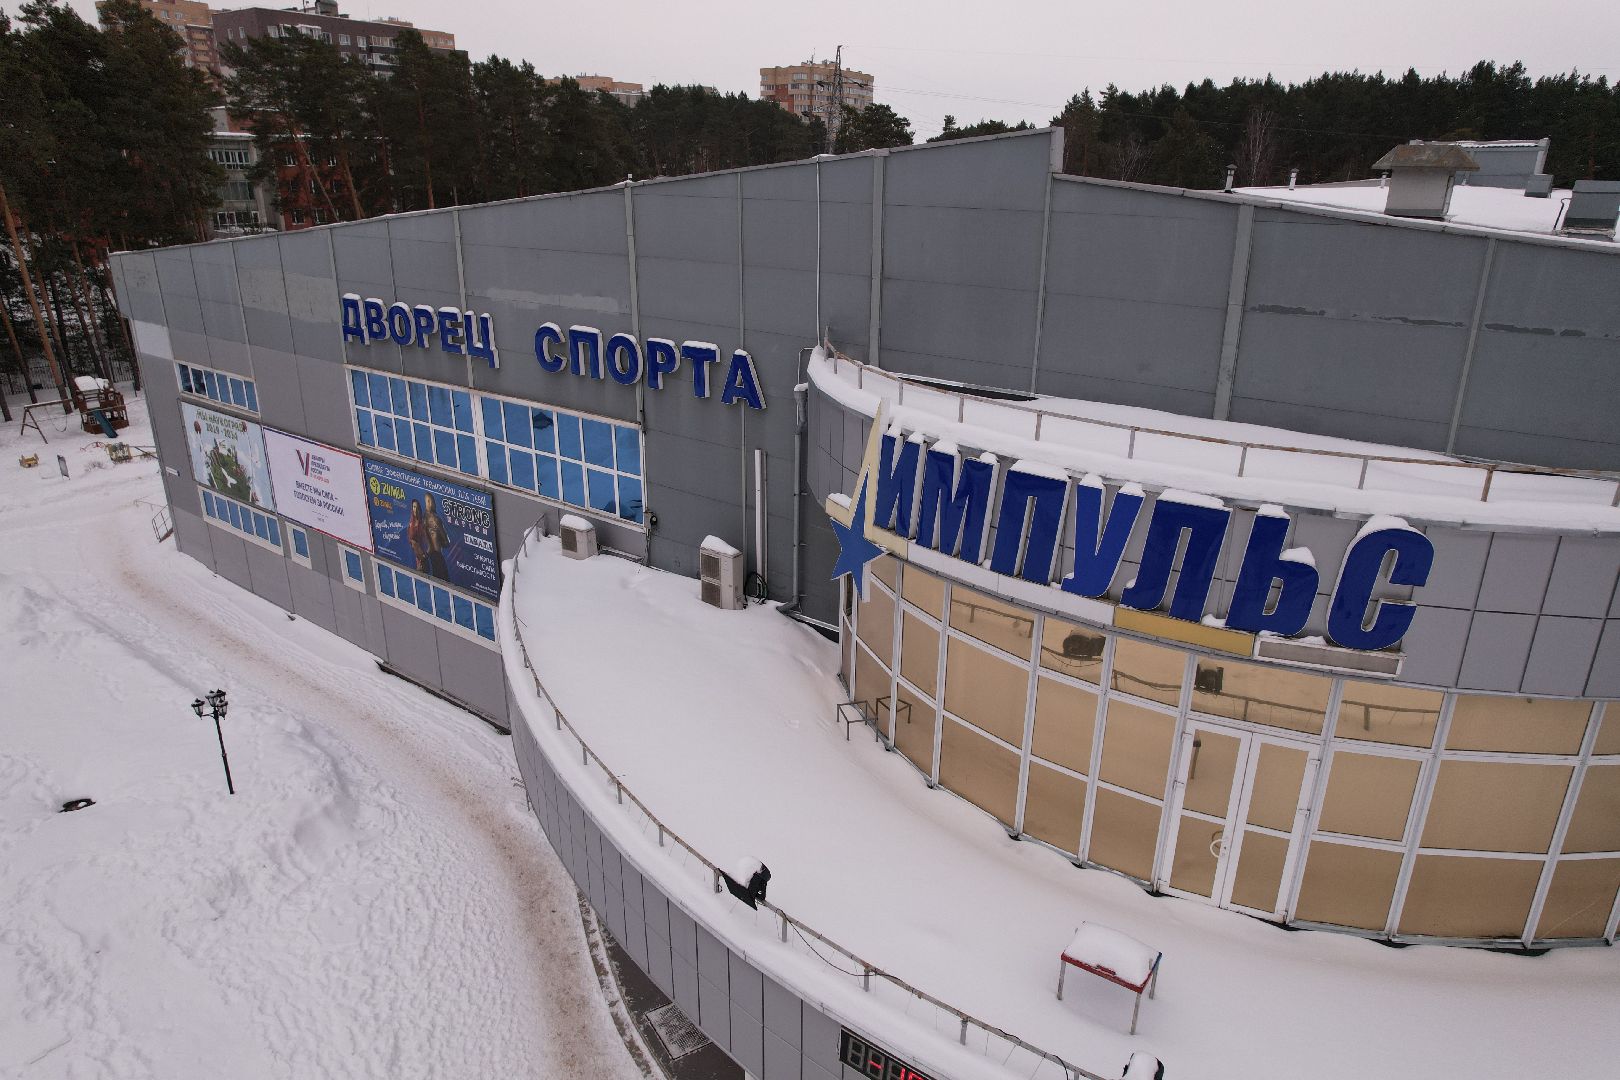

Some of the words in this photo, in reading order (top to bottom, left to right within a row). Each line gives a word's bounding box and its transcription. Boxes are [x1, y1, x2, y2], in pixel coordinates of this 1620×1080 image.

[342, 293, 499, 369] ДВОРЕЦ
[535, 322, 767, 410] СПОРТА
[381, 482, 406, 501] ZUMBA
[442, 498, 491, 529] STRONG
[872, 430, 1435, 651] ИМПУЛЬС
